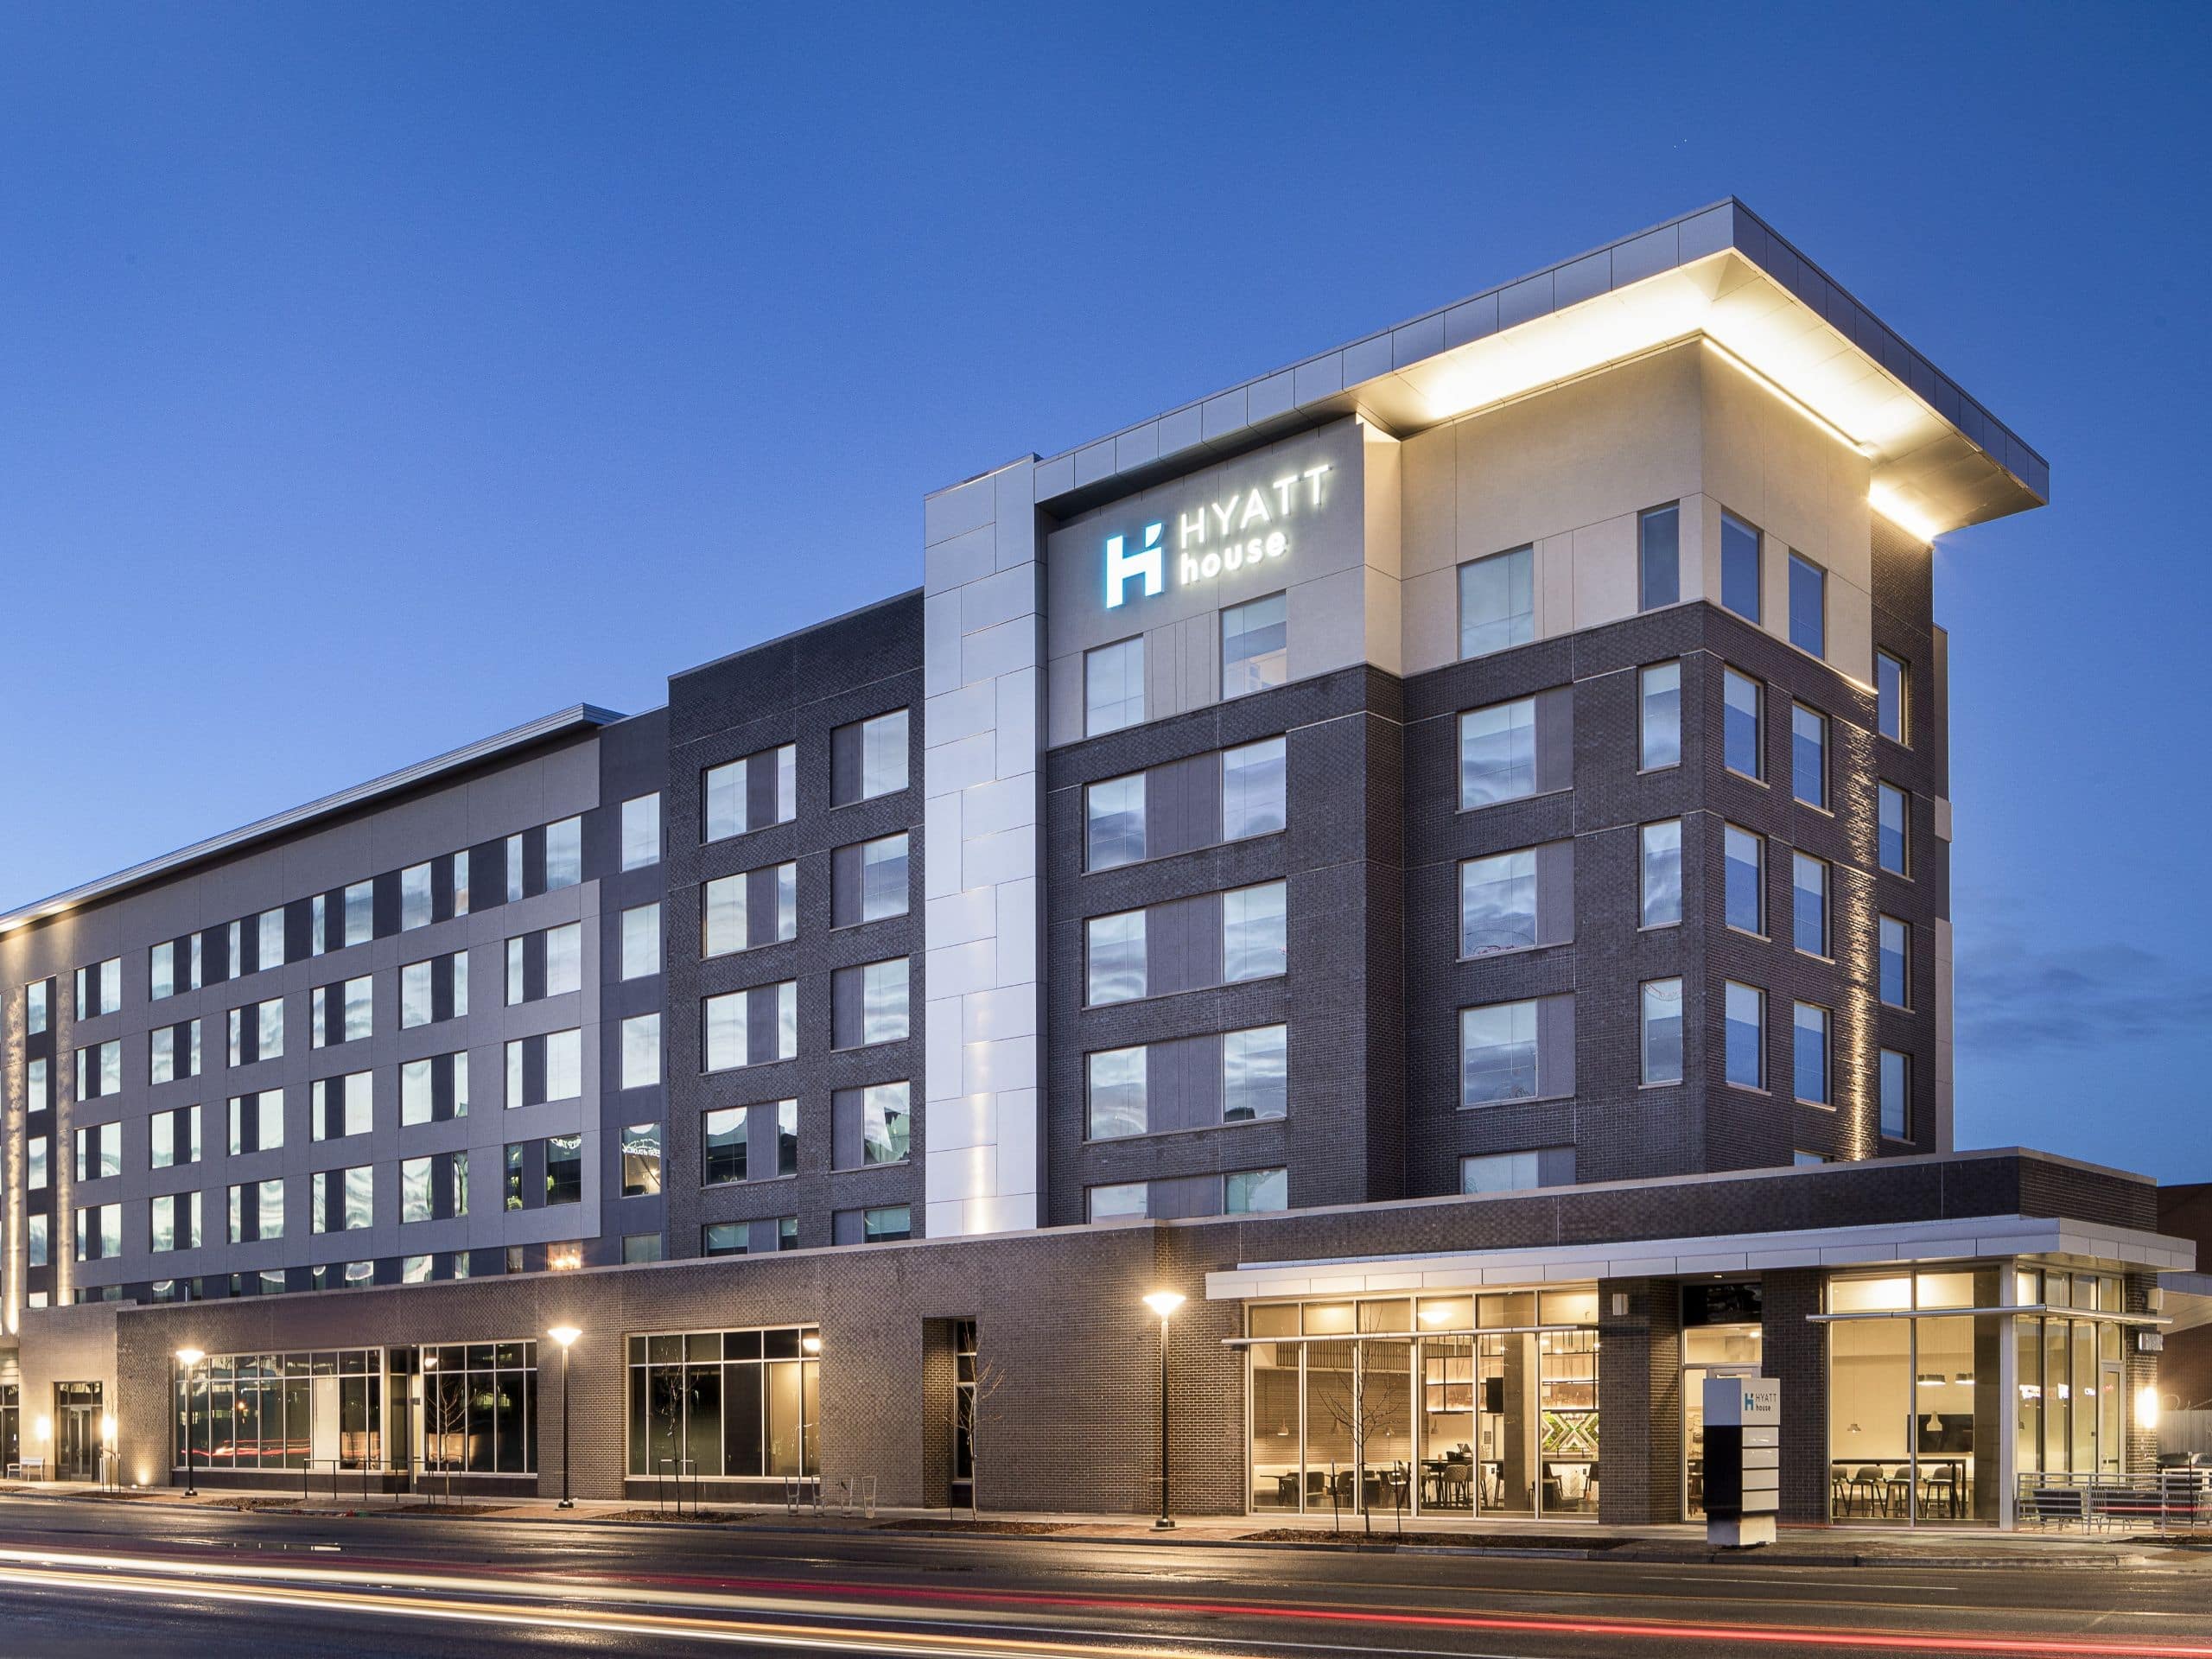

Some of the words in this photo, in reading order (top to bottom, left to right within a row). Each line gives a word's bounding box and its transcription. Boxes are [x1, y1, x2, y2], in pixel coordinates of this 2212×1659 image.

[1180, 463, 1330, 549] HYATT
[1180, 531, 1288, 585] house
[1755, 1393, 1777, 1402] HYATT
